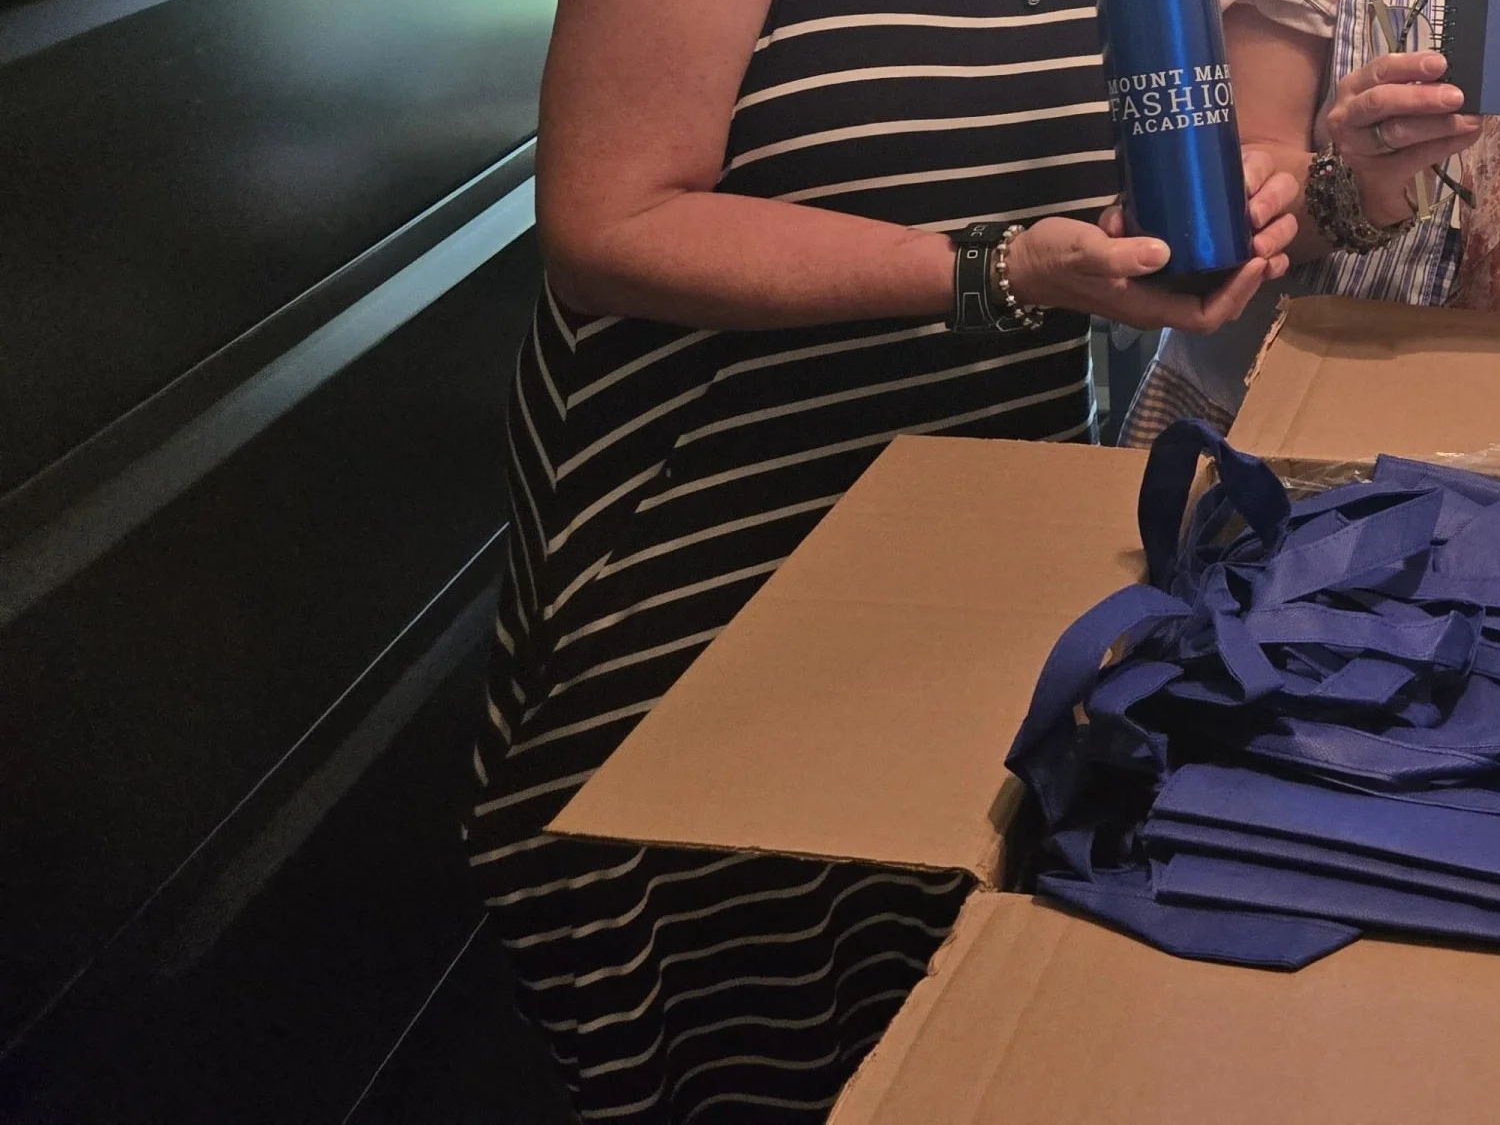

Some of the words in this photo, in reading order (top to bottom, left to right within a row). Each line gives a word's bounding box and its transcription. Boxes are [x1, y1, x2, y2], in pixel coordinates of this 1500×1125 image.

[1107, 68, 1184, 95] MOUNT
[1194, 63, 1231, 83] MAR
[1132, 108, 1230, 135] ACADEMY
